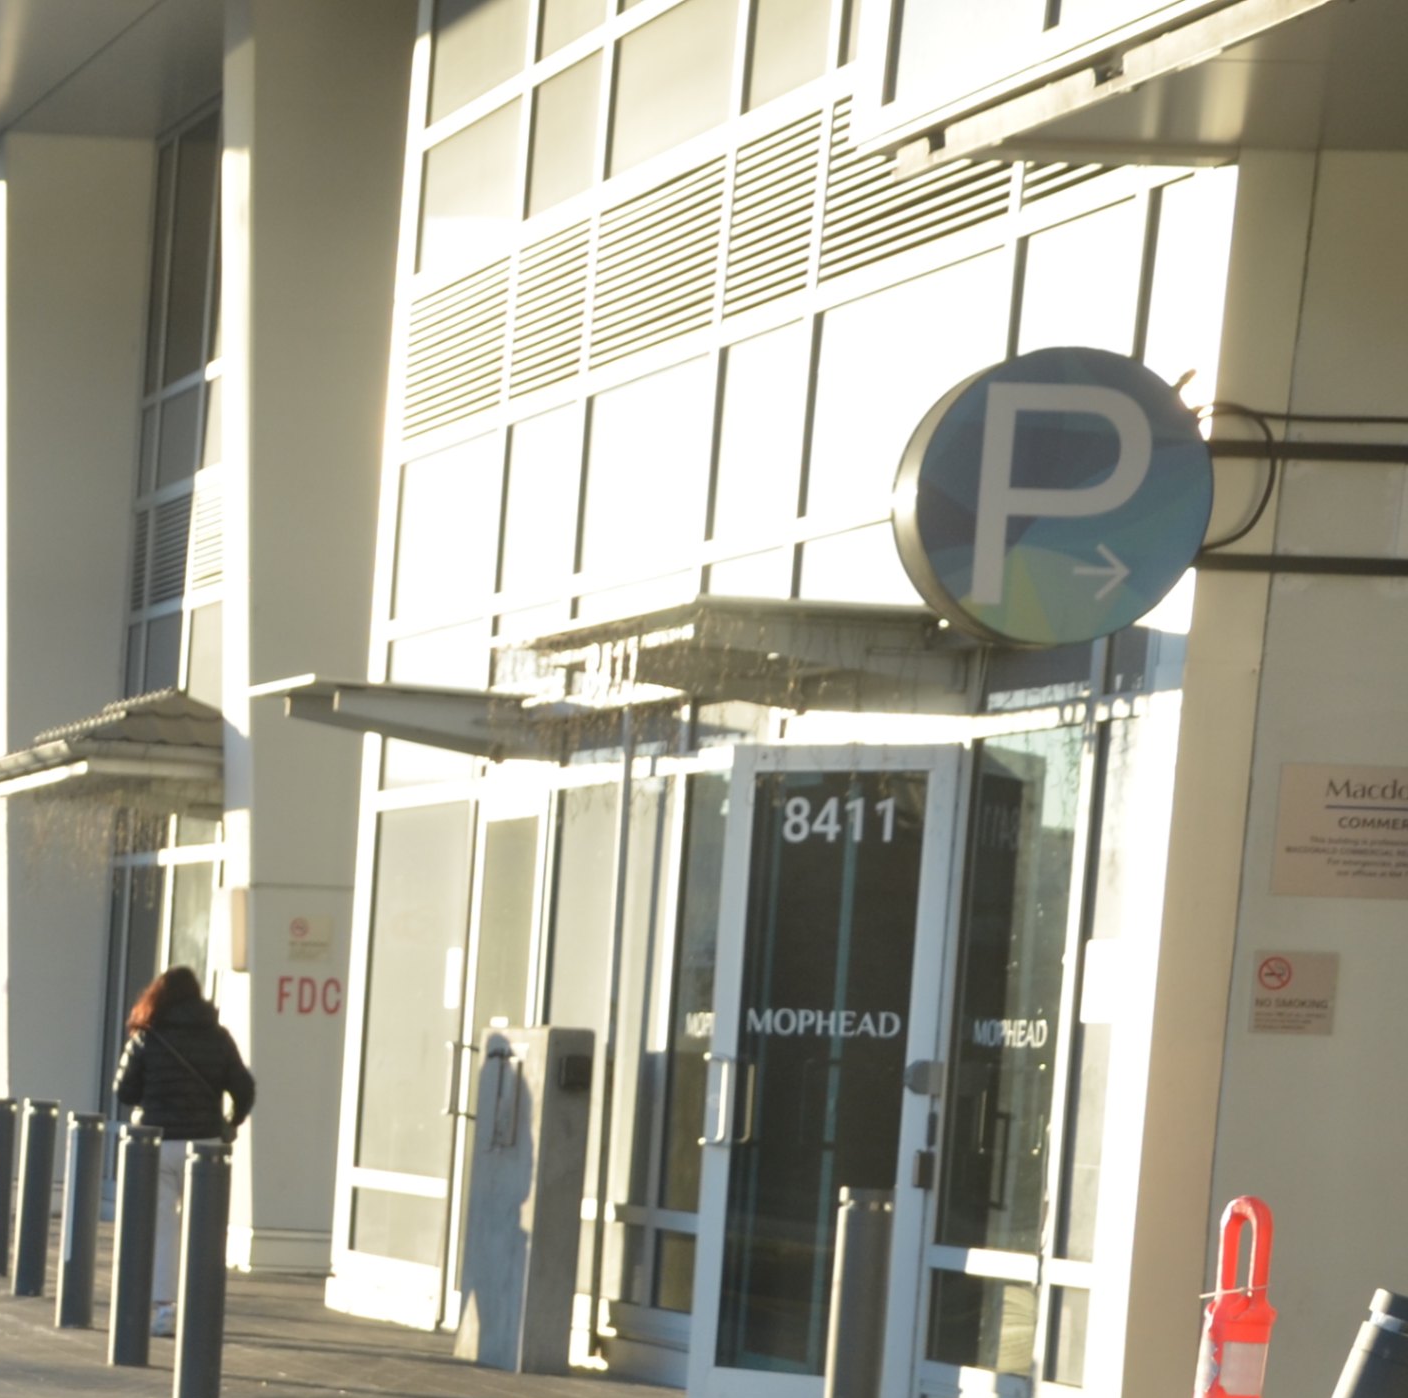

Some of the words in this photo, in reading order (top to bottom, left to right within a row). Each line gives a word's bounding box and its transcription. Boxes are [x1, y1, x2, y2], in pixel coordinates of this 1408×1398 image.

[971, 382, 1152, 605] P
[782, 796, 896, 843] 8411
[277, 975, 342, 1015] FDC
[1255, 997, 1272, 1008] NO
[1275, 997, 1328, 1009] SMOKING
[746, 1007, 901, 1038] MOPHEAD
[973, 1018, 1049, 1048] MOPHEAD
